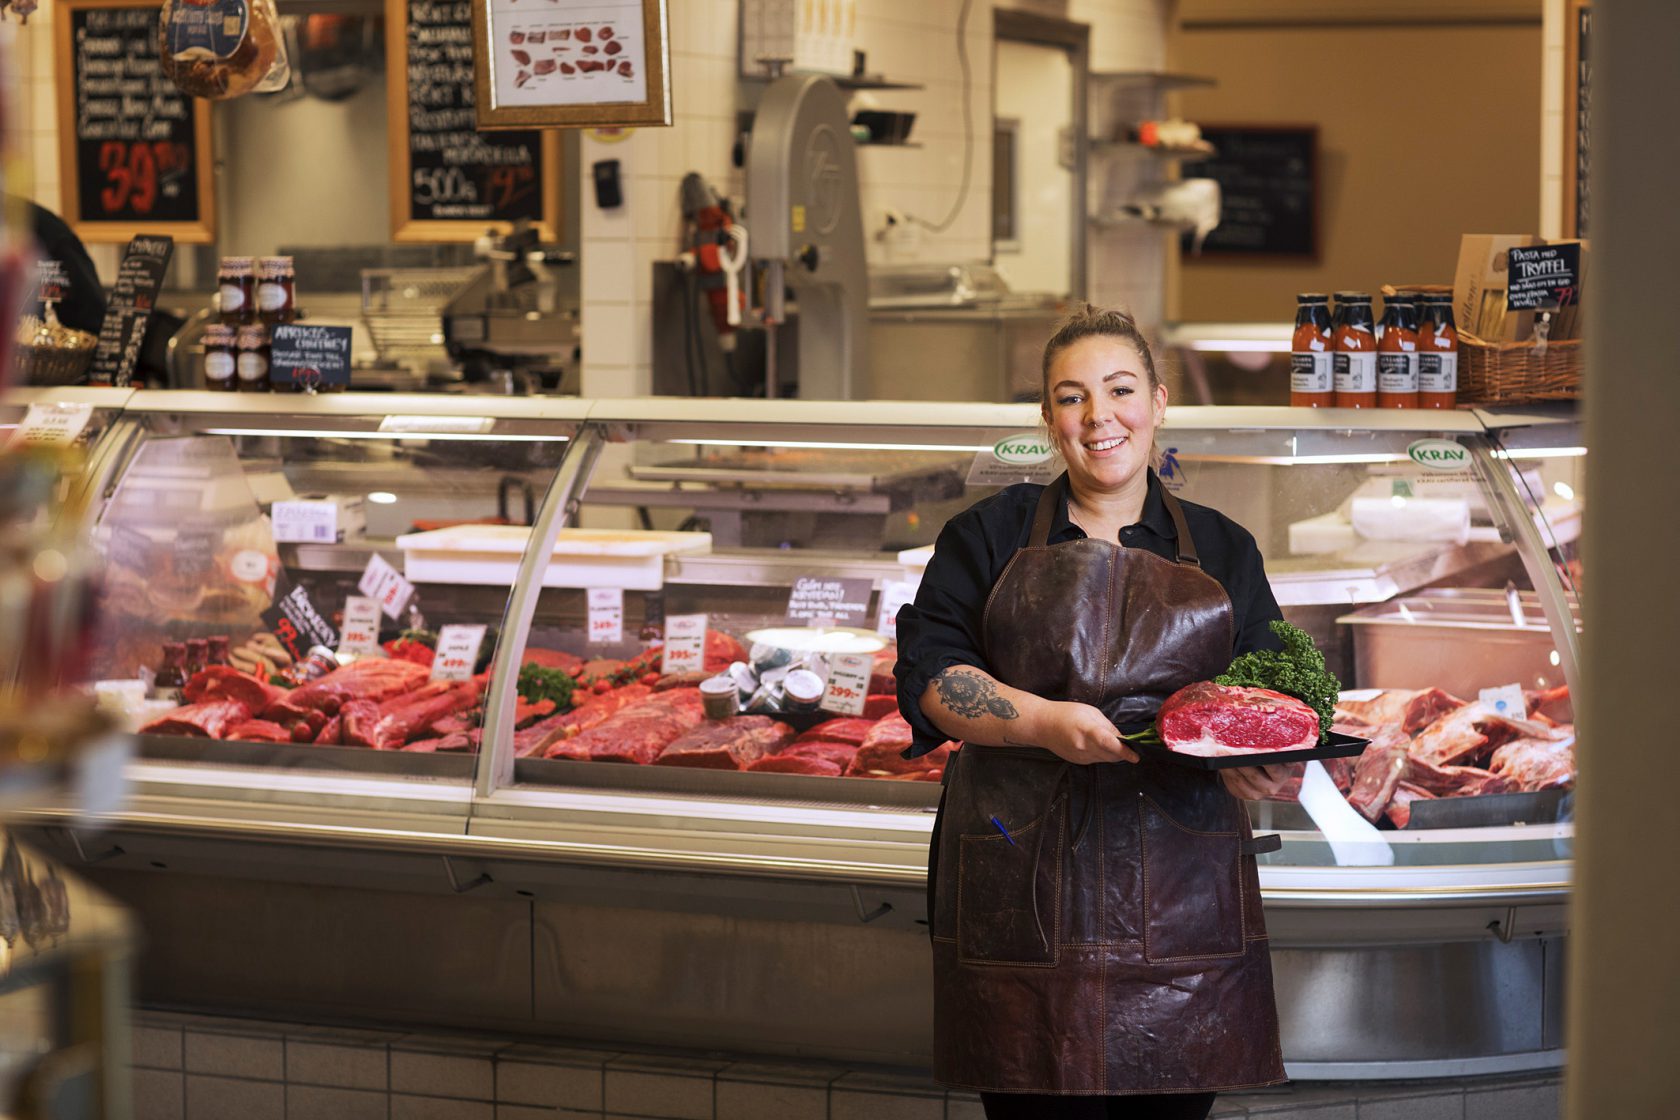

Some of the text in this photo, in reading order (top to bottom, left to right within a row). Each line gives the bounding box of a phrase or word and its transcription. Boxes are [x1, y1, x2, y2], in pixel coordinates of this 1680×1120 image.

[1511, 249, 1557, 261] PASTA MED
[1516, 259, 1571, 277] TRYFFEL
[1001, 444, 1050, 455] KRAV
[1416, 449, 1464, 460] KRAV
[829, 685, 860, 699] 299:-
